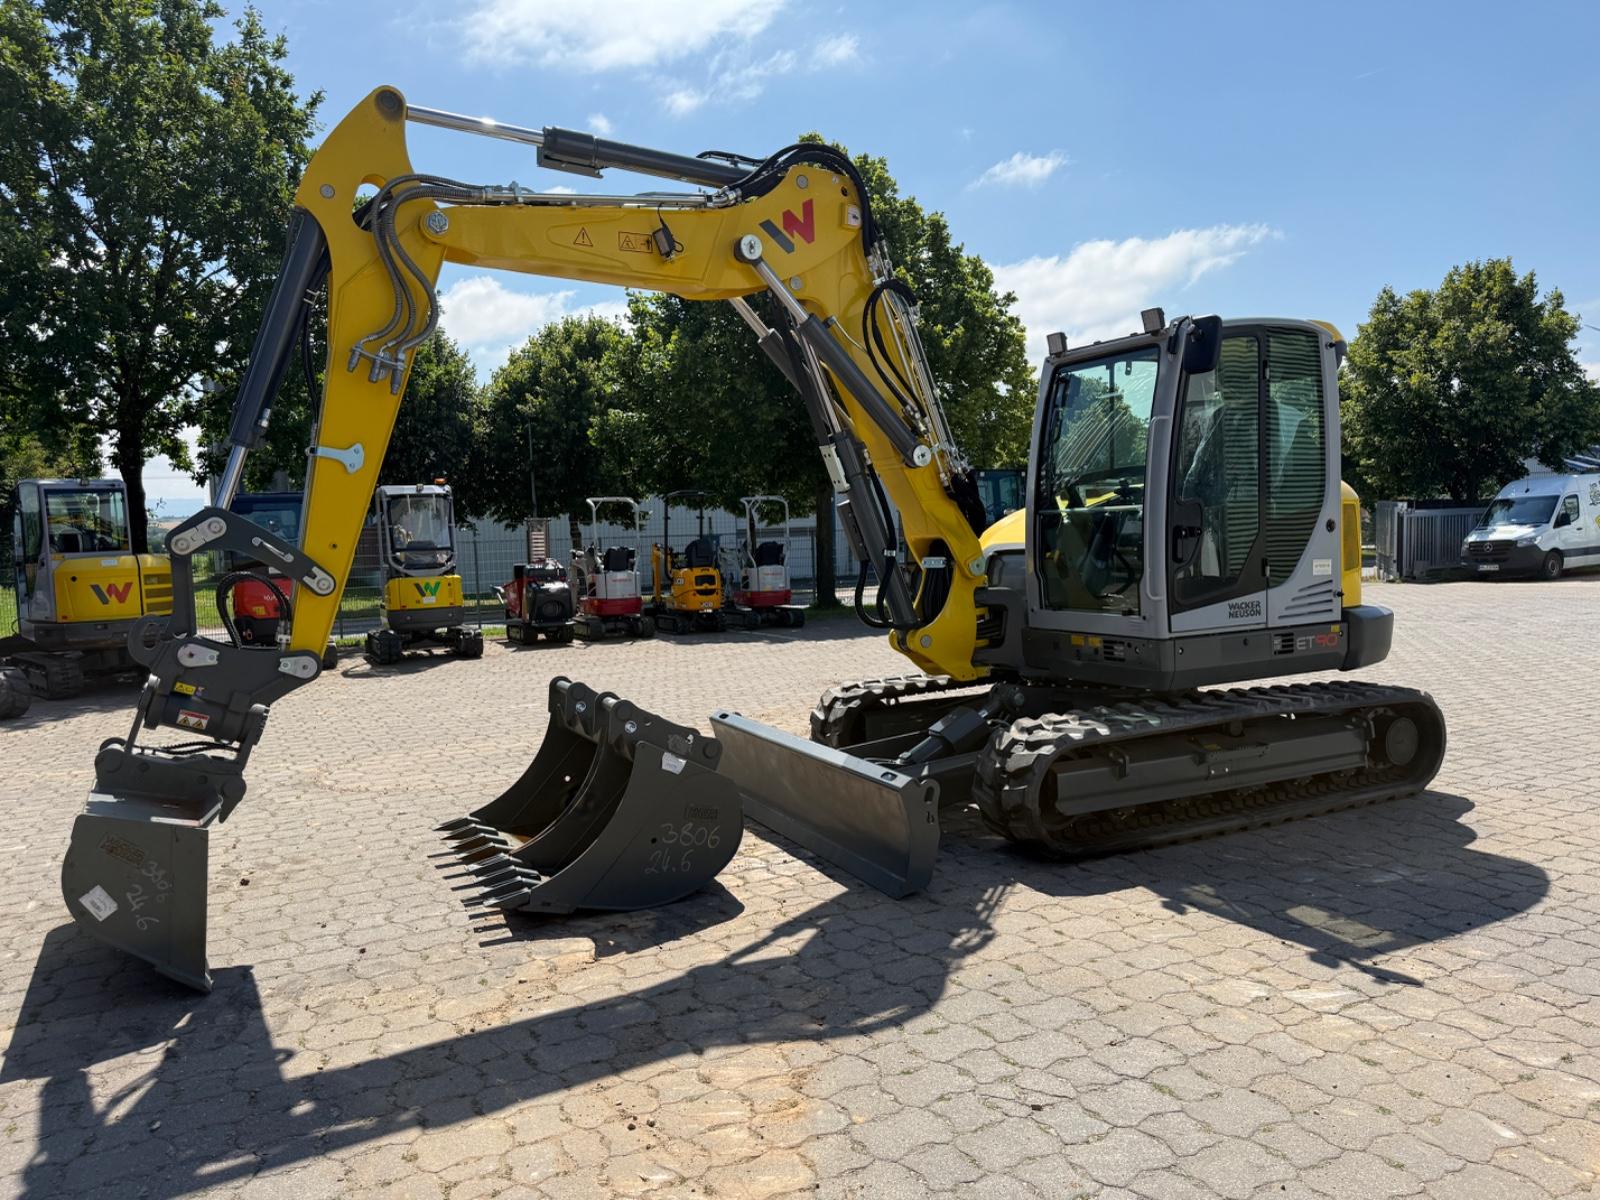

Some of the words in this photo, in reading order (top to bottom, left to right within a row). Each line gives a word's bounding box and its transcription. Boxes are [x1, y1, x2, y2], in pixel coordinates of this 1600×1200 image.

[1228, 601, 1261, 611] WACKER
[1229, 609, 1262, 619] NEUSON
[1296, 633, 1338, 650] ET90
[661, 822, 720, 848] 3806
